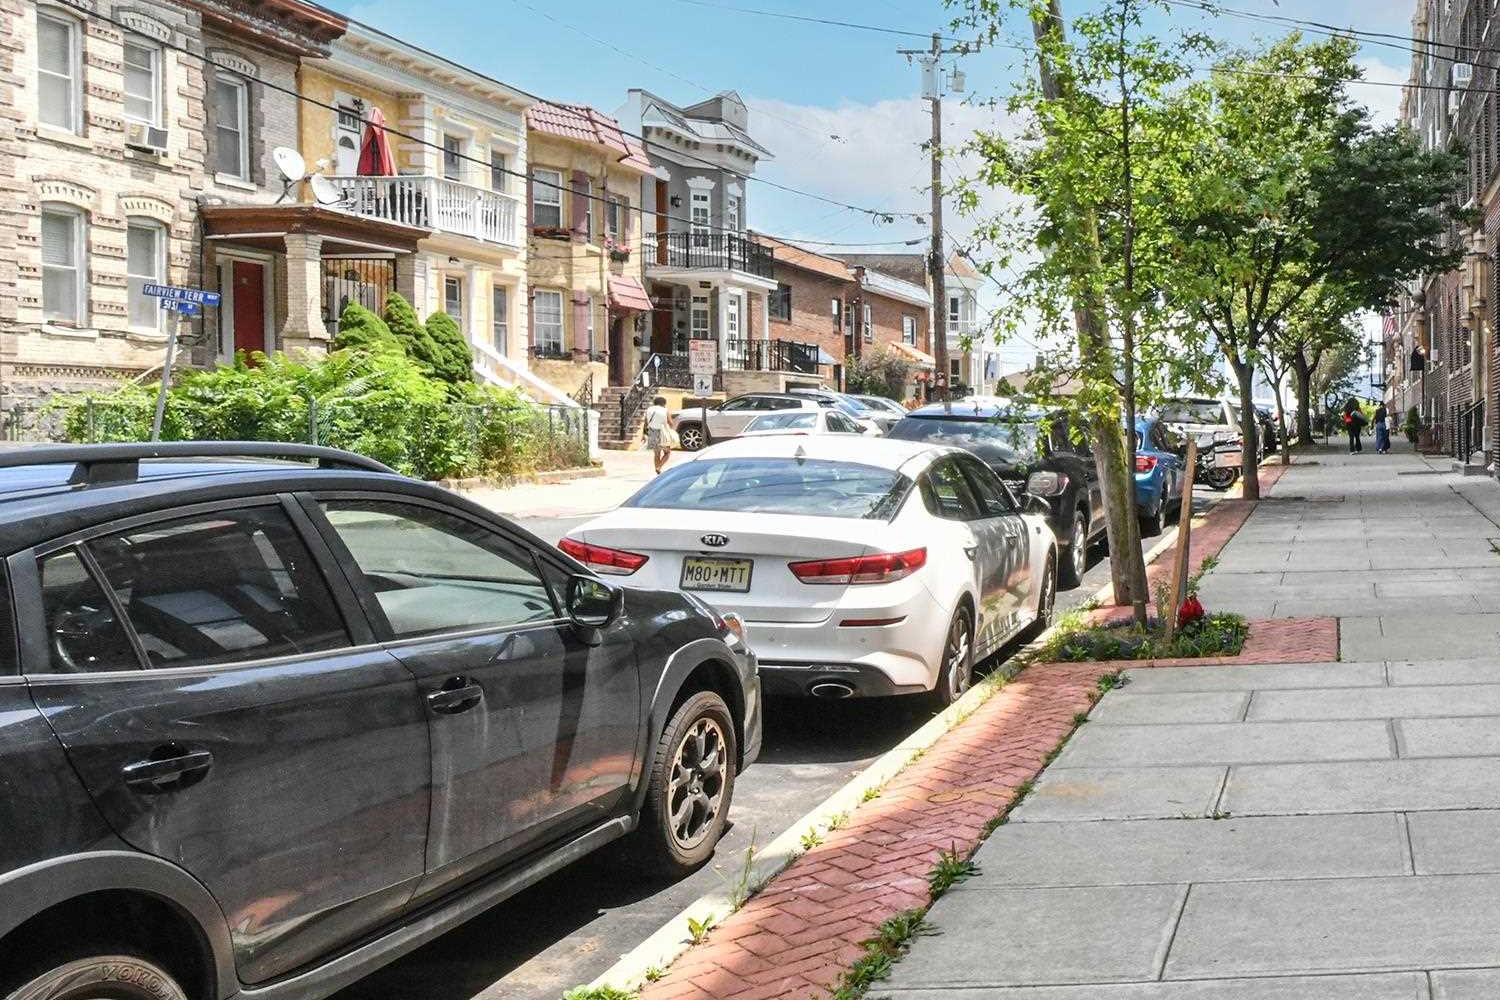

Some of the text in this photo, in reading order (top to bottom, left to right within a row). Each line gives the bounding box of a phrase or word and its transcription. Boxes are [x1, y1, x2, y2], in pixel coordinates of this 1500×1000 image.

[144, 285, 180, 298] FAIRVIEW
[184, 291, 204, 302] TERR
[704, 535, 725, 545] KIA
